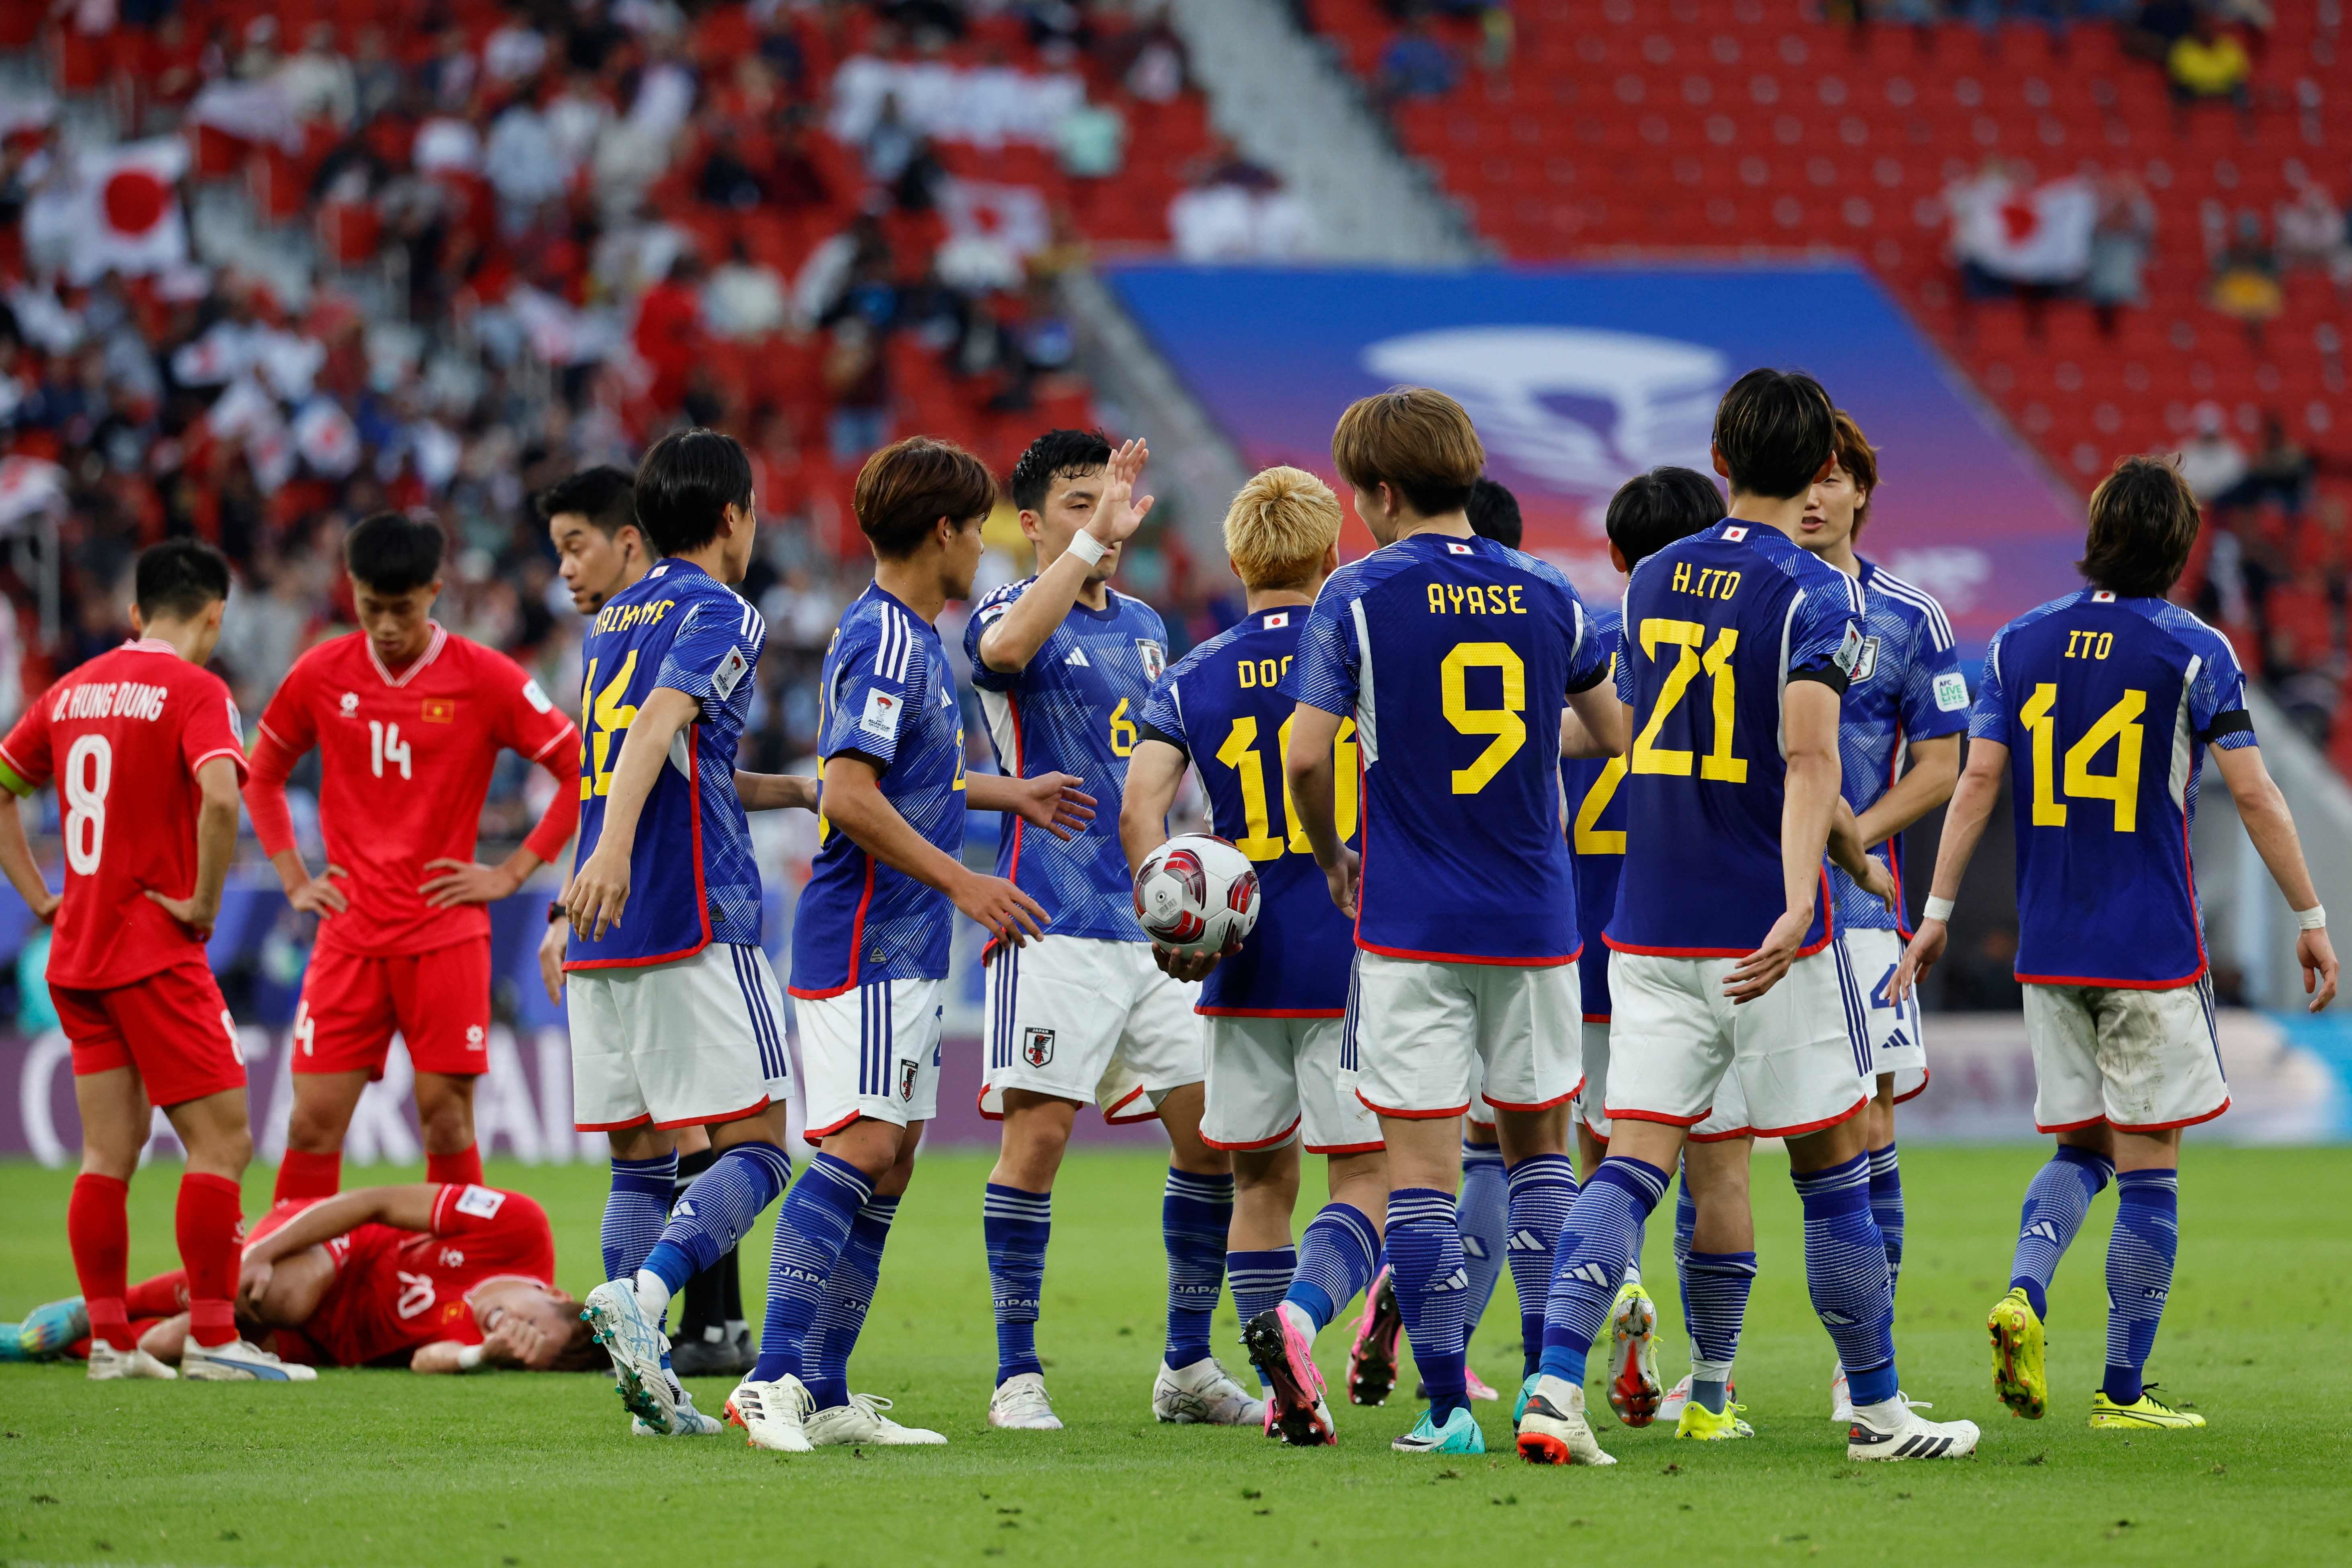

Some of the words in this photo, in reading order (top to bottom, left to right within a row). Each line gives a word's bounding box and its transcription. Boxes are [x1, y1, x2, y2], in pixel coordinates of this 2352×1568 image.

[1427, 583, 1527, 614] AYASE
[1672, 561, 1741, 600] H.ITO
[2064, 630, 2114, 660] ITO
[68, 682, 117, 719] HUNG
[112, 681, 168, 722] DUNG
[1441, 642, 1526, 794] 9
[1631, 618, 1748, 783] 21
[1940, 684, 1962, 696] LIVE
[369, 720, 411, 780] 14
[1109, 698, 1137, 757] 6
[2019, 682, 2147, 832] 14
[65, 734, 112, 876] 8
[1216, 712, 1358, 861] 10
[1870, 964, 1904, 1020] 4
[294, 1000, 315, 1057] 4
[819, 1412, 836, 1421] COPA
[1465, 1422, 1475, 1450] PHANTOM
